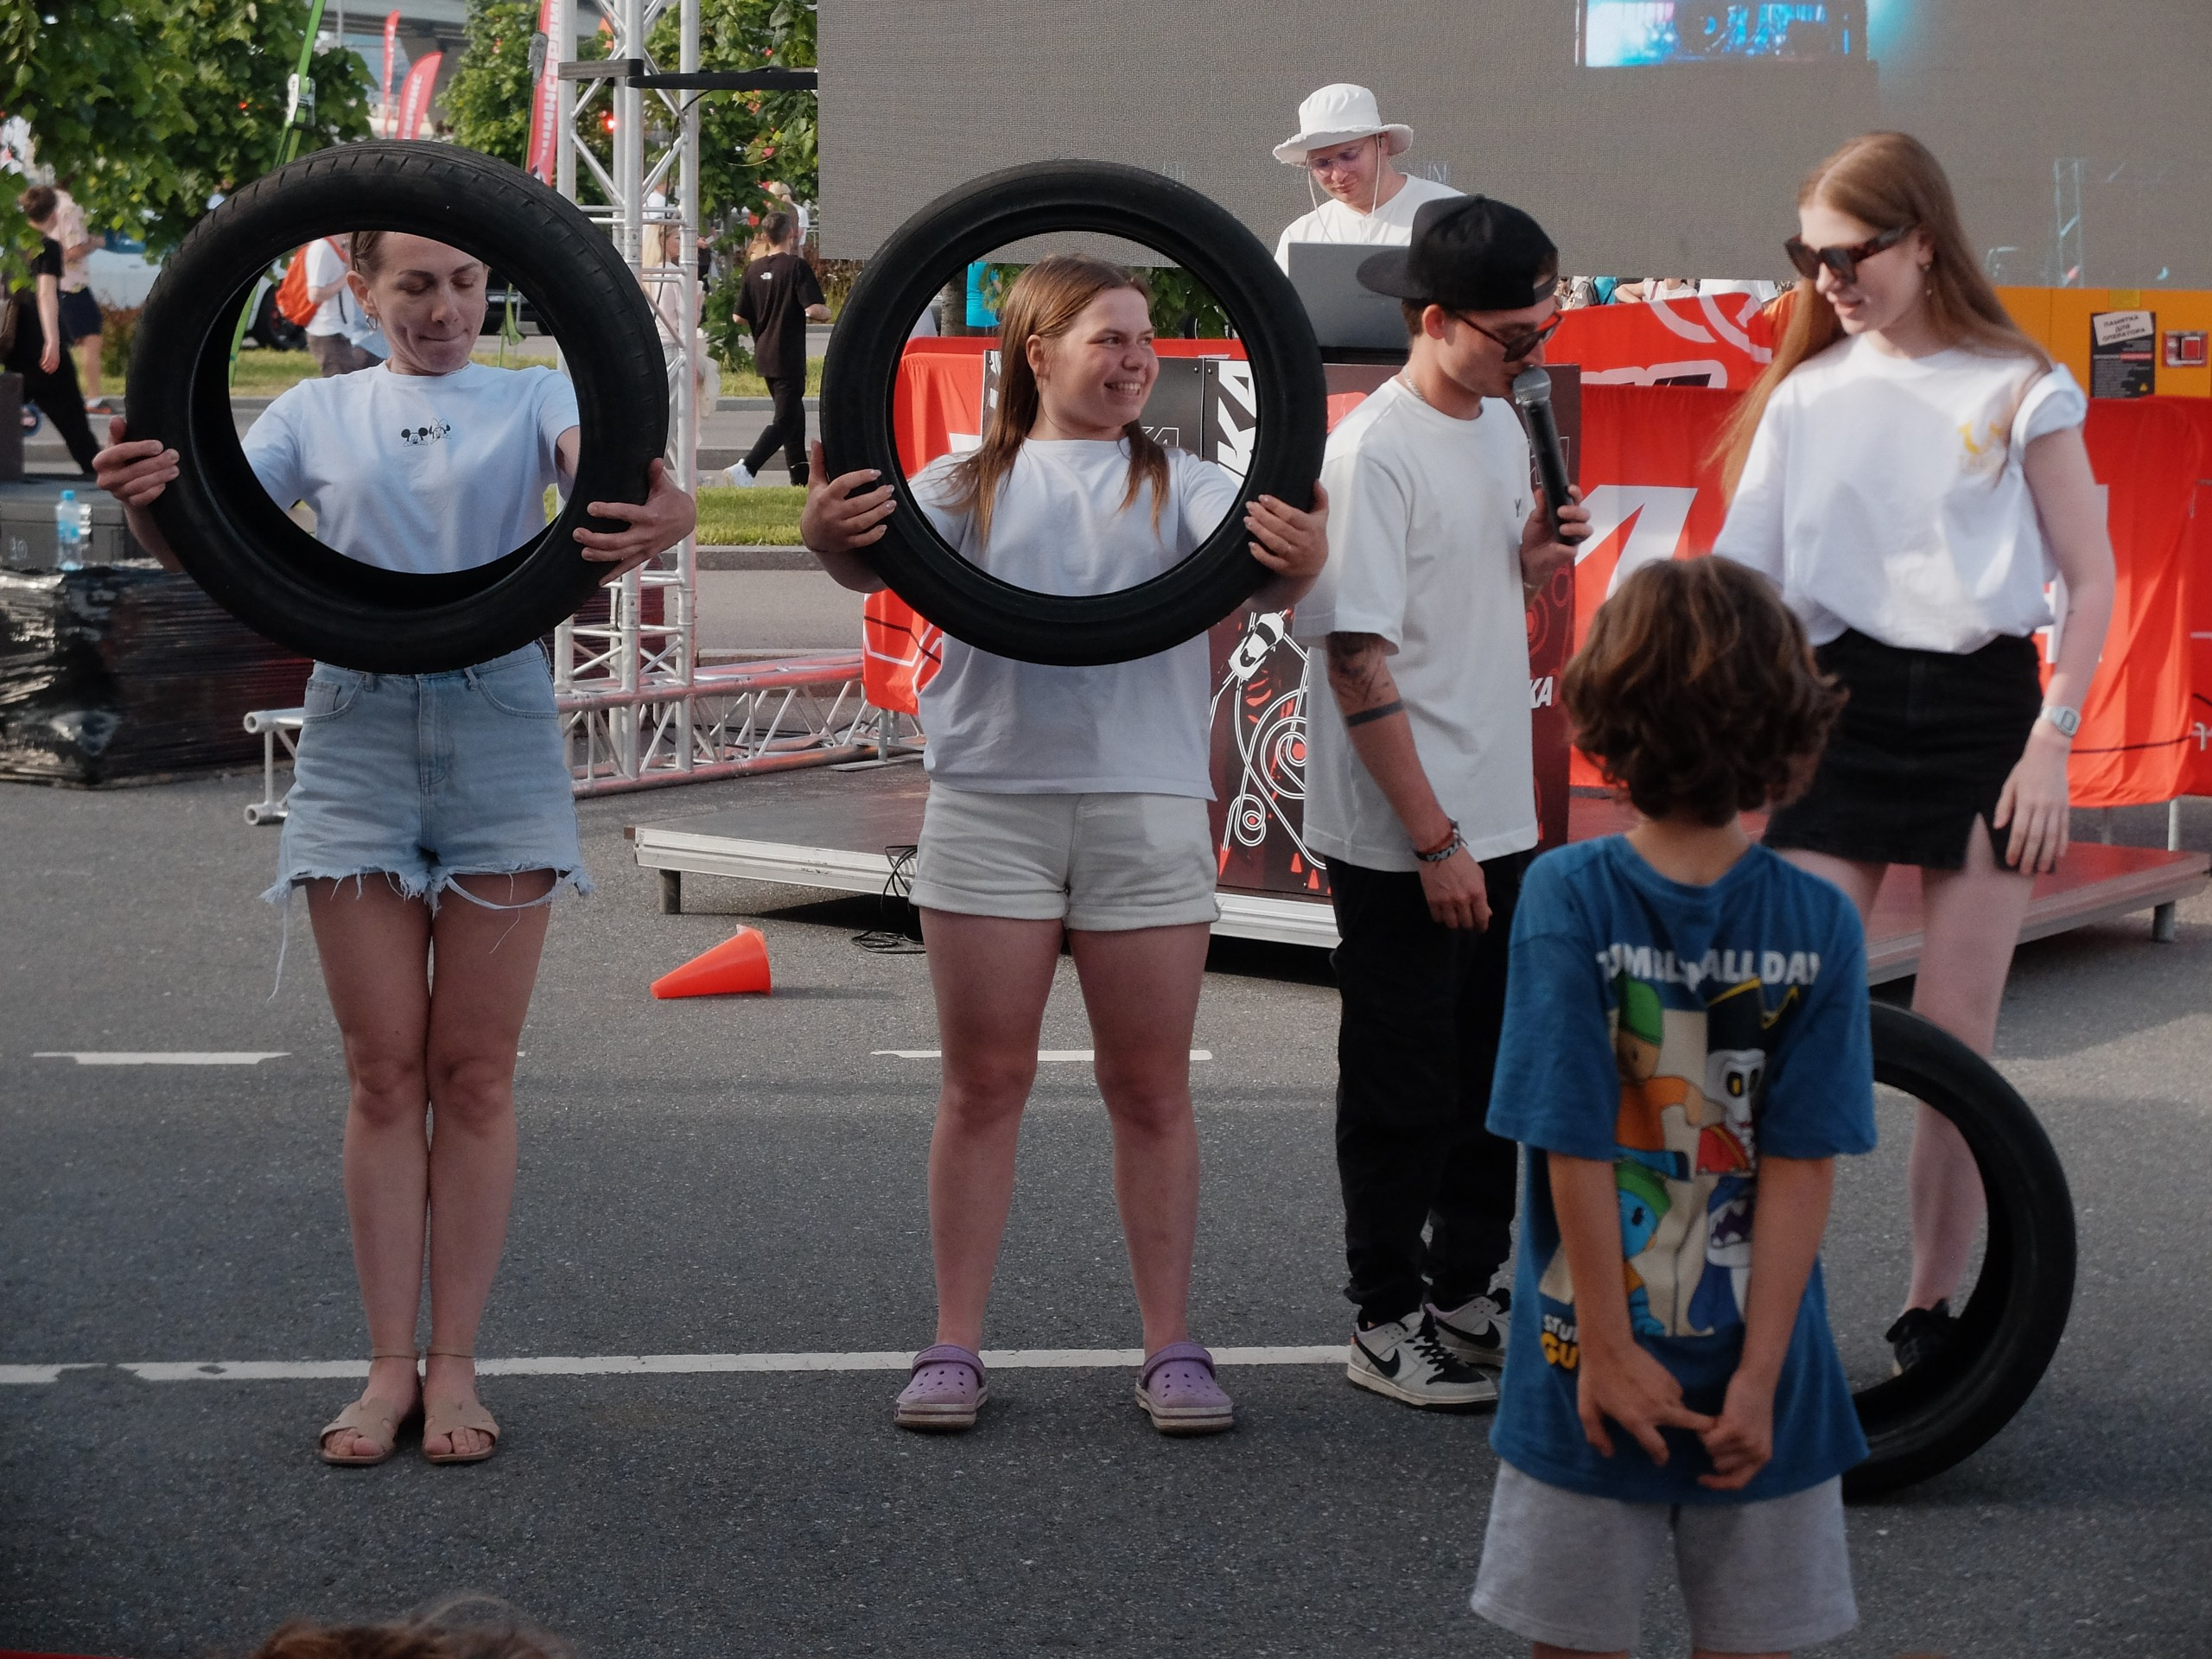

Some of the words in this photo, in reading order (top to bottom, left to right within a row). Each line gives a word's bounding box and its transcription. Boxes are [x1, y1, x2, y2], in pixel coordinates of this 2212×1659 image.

[542, 0, 561, 156] ШИНСЕРВИ
[1700, 949, 1759, 984] ALL
[1541, 1332, 1579, 1370] GU
